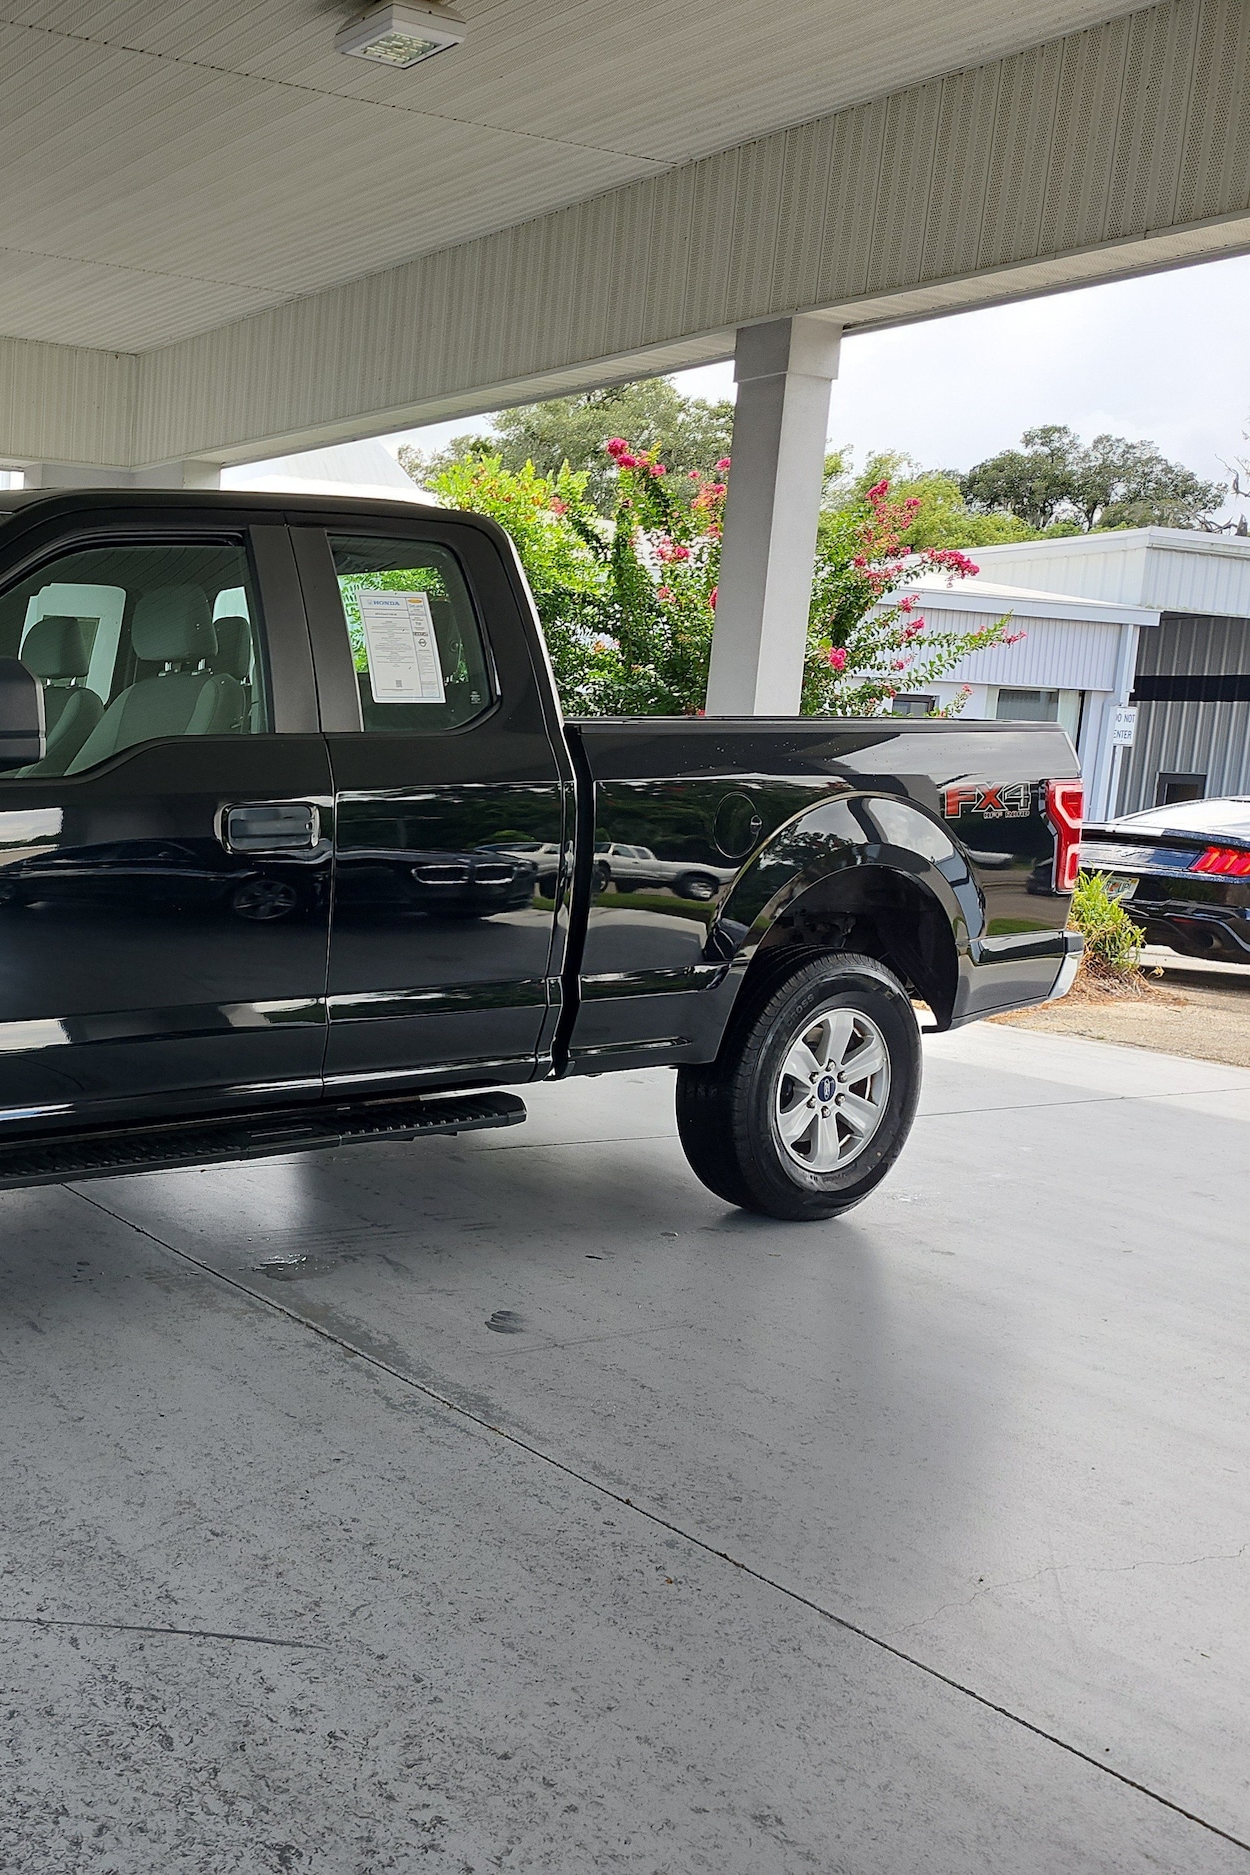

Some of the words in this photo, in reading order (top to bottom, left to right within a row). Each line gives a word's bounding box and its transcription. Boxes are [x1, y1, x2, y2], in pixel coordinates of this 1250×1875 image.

[1123, 713, 1136, 723] NOT
[1113, 729, 1133, 740] ENTER
[944, 781, 1032, 819] FX4
